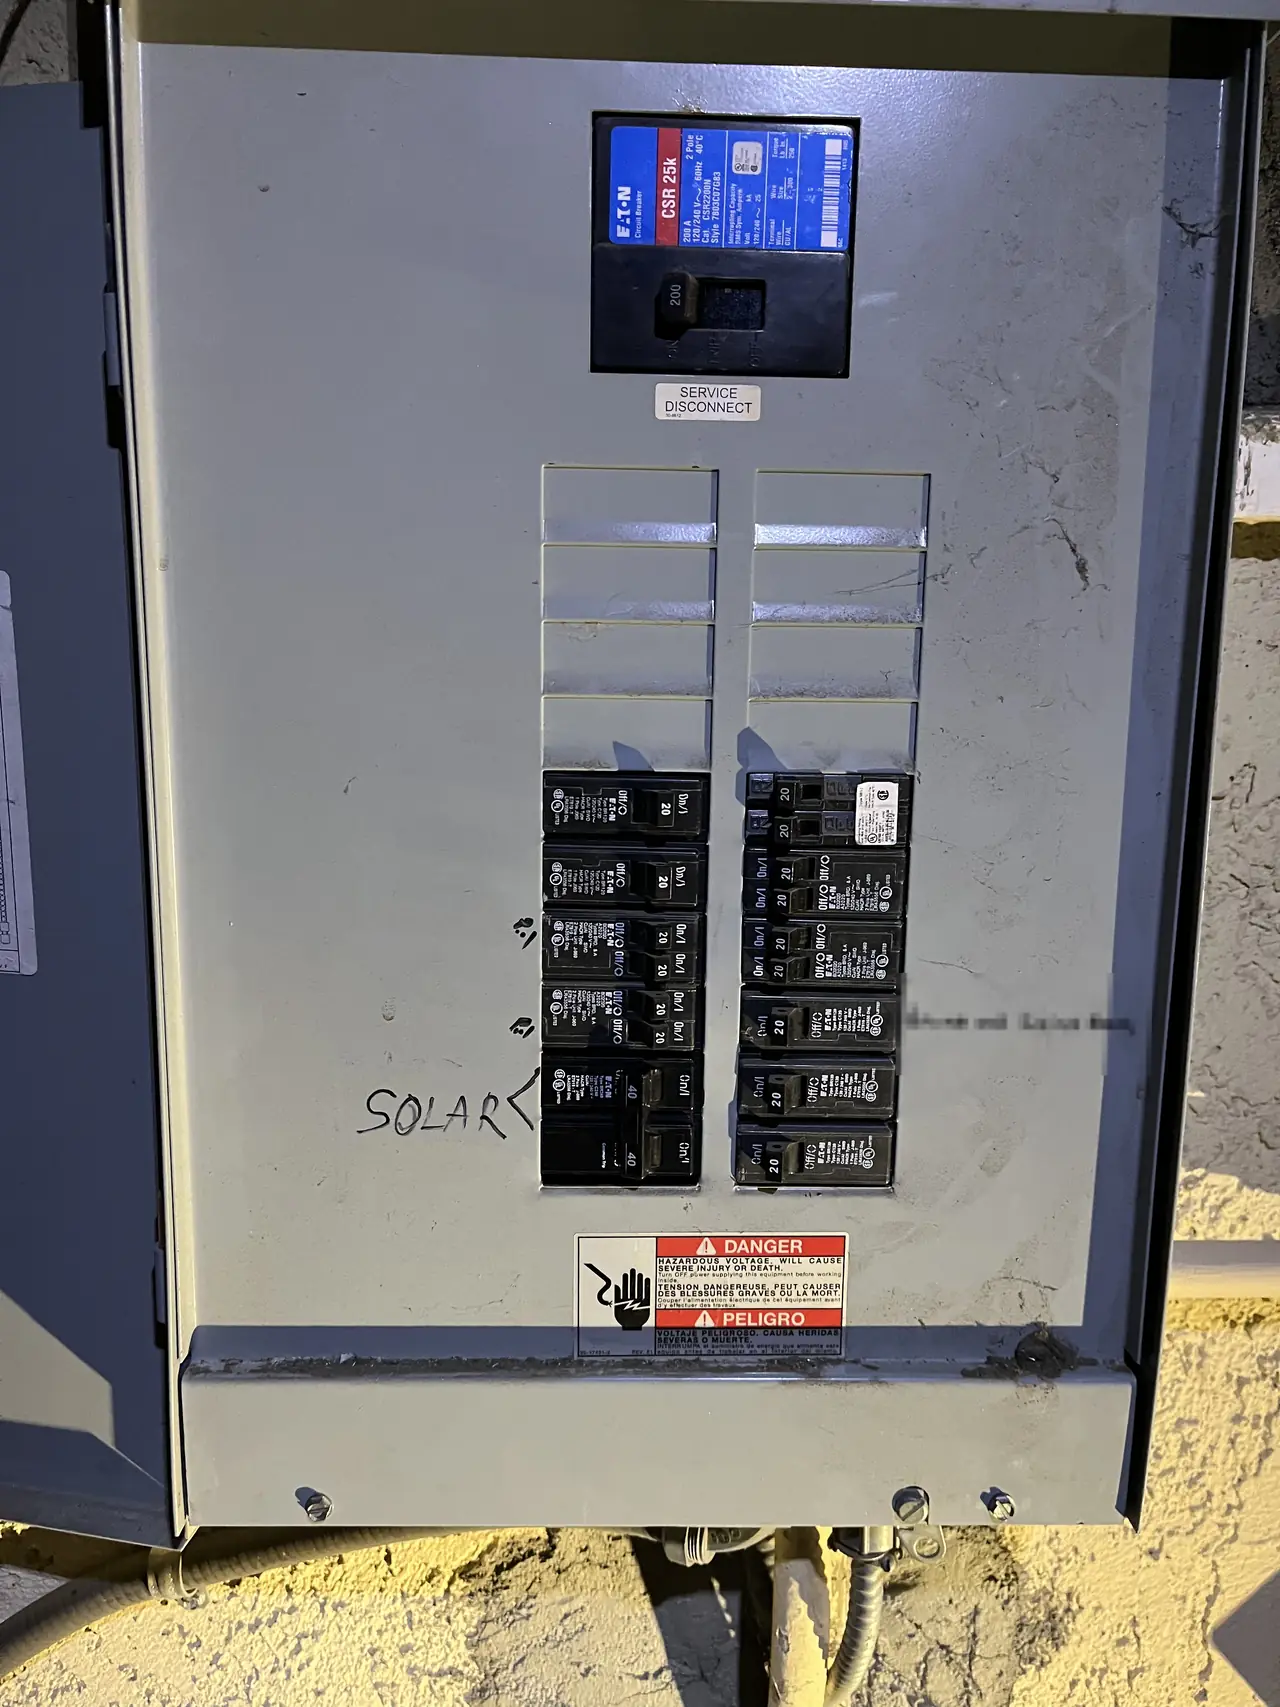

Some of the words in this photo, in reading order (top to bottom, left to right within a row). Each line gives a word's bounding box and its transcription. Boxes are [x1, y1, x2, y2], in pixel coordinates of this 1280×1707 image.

[686, 134, 695, 152] Pole
[662, 157, 677, 184] 25k
[694, 161, 704, 181] 60Hz
[635, 190, 643, 215] Breaker
[702, 178, 712, 221] CSR2200N
[728, 183, 738, 209] Capacity
[745, 194, 753, 202] kA
[755, 194, 763, 202] 25
[662, 189, 677, 219] CSR
[692, 209, 702, 243] 120/240
[683, 228, 692, 243] 200
[702, 227, 711, 243] Cat.
[711, 223, 721, 244] Style
[670, 284, 681, 306] 200
[680, 387, 738, 399] SERVICE
[666, 401, 753, 413] DISCONNECT
[780, 787, 790, 802] 20
[661, 803, 671, 816] 20
[780, 824, 789, 838] 20
[781, 868, 791, 881] 20
[658, 876, 669, 889] 20
[777, 895, 787, 907] 20
[658, 932, 668, 944] 20
[776, 938, 786, 950] 20
[657, 965, 668, 977] 20
[774, 965, 784, 977] 20
[656, 1003, 666, 1016] 20
[774, 1020, 785, 1035] 20
[655, 1032, 665, 1044] 20
[628, 1085, 638, 1099] 40
[772, 1092, 782, 1108] 20
[356, 1088, 508, 1140] SOLAR
[627, 1152, 636, 1167] 40
[770, 1159, 779, 1174] 20
[725, 1240, 802, 1254] DANGER
[723, 1312, 805, 1326] PELIGRO
